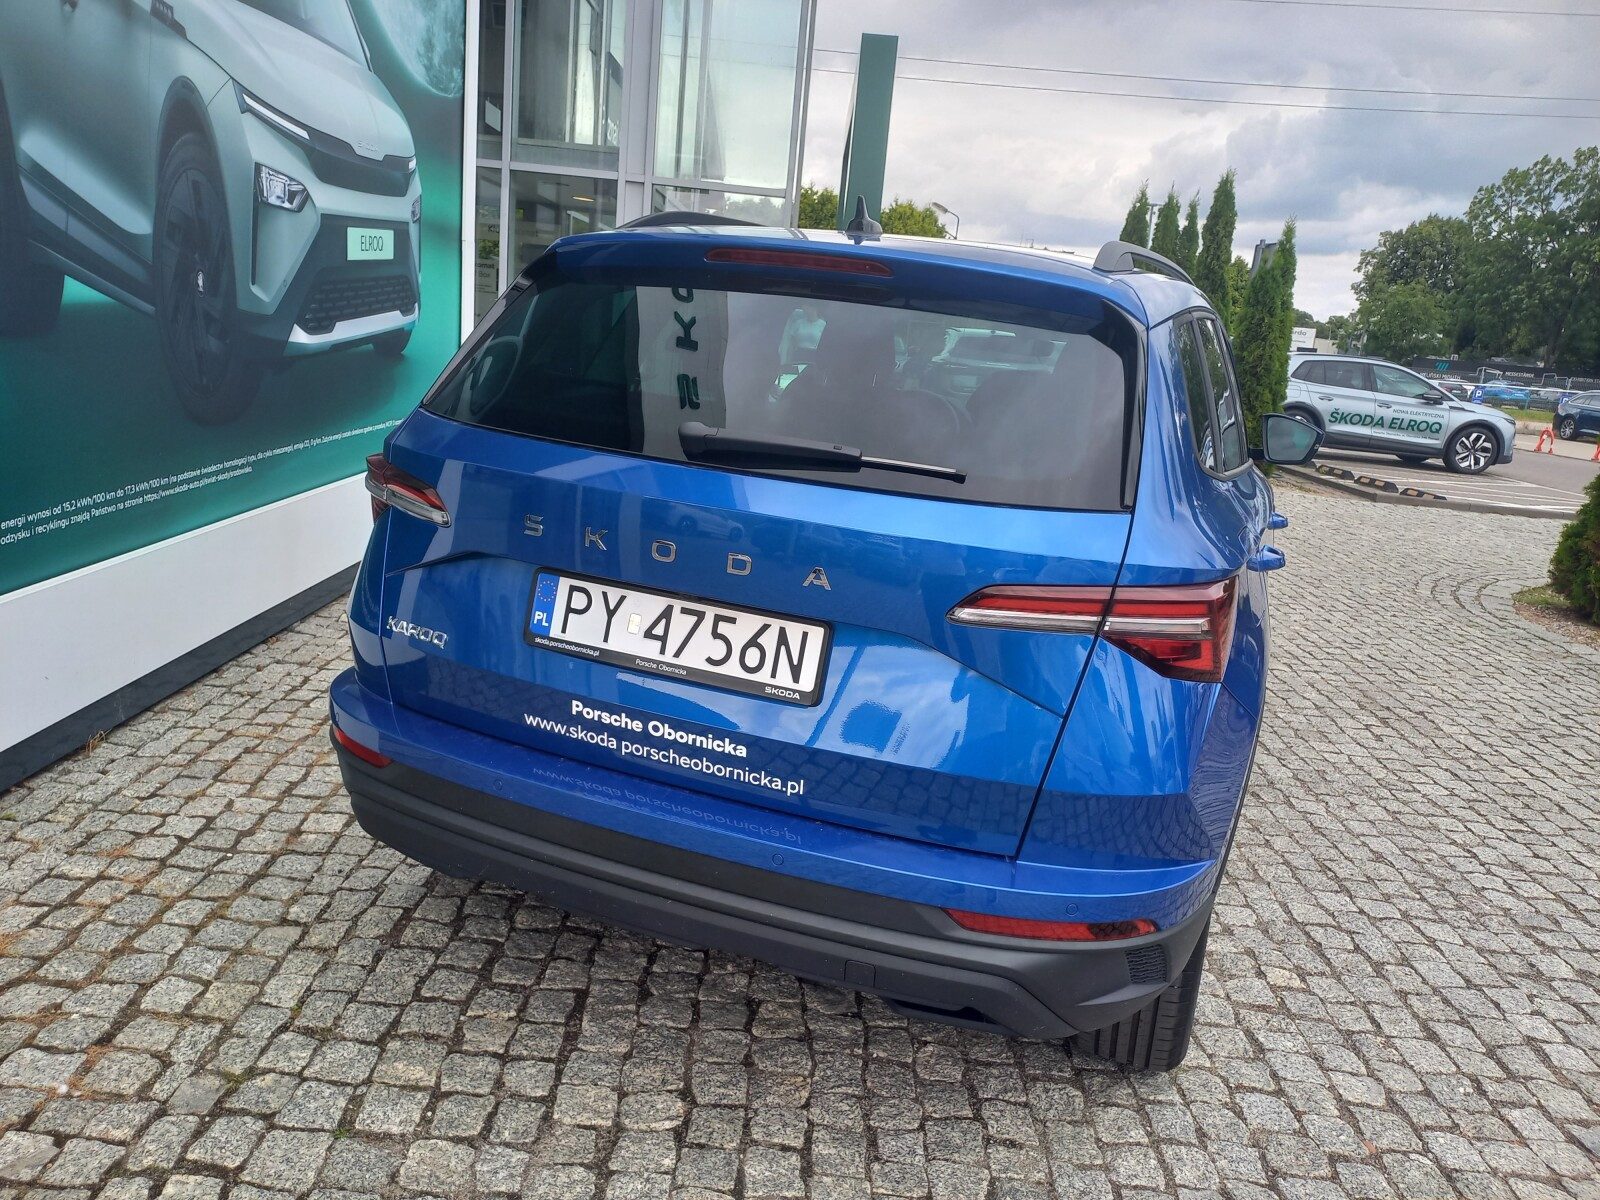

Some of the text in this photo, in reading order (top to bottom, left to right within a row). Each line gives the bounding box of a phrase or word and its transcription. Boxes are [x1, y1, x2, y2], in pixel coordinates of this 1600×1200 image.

[361, 235, 383, 251] ELROQ
[1475, 390, 1482, 398] P
[1328, 407, 1443, 434] ŠKODA ELROQ
[1409, 410, 1445, 419] ELEKTRYCZNA
[1, 514, 26, 530] energii
[27, 506, 52, 522] wynosi
[52, 504, 62, 515] od
[63, 500, 76, 512] 15,2
[76, 492, 105, 508] kWh/100
[106, 490, 116, 500] km
[116, 488, 124, 498] do
[124, 484, 136, 496] 17,3
[136, 478, 160, 492] kWh/100
[160, 475, 169, 486] km
[169, 474, 177, 485] (na
[177, 467, 200, 482] podstawie
[0, 528, 31, 545] odzysku
[31, 526, 34, 536] i
[35, 516, 69, 534] recyklingu
[71, 511, 90, 523] znajdą
[91, 503, 116, 518] Państwo
[117, 501, 124, 510] na
[124, 495, 143, 508] stronie
[524, 515, 831, 591] SKODA
[386, 616, 448, 649] KAROQ
[534, 611, 549, 627] PL
[534, 636, 599, 656] skoda.porscheobornicka.pl
[561, 584, 809, 684] PY 4756N
[635, 658, 687, 675] Porsche Obornicka
[765, 686, 800, 700] SKODA
[571, 700, 747, 758] Porsche Obornicka
[524, 713, 804, 797] www.skoda porscheobornicka.pl
